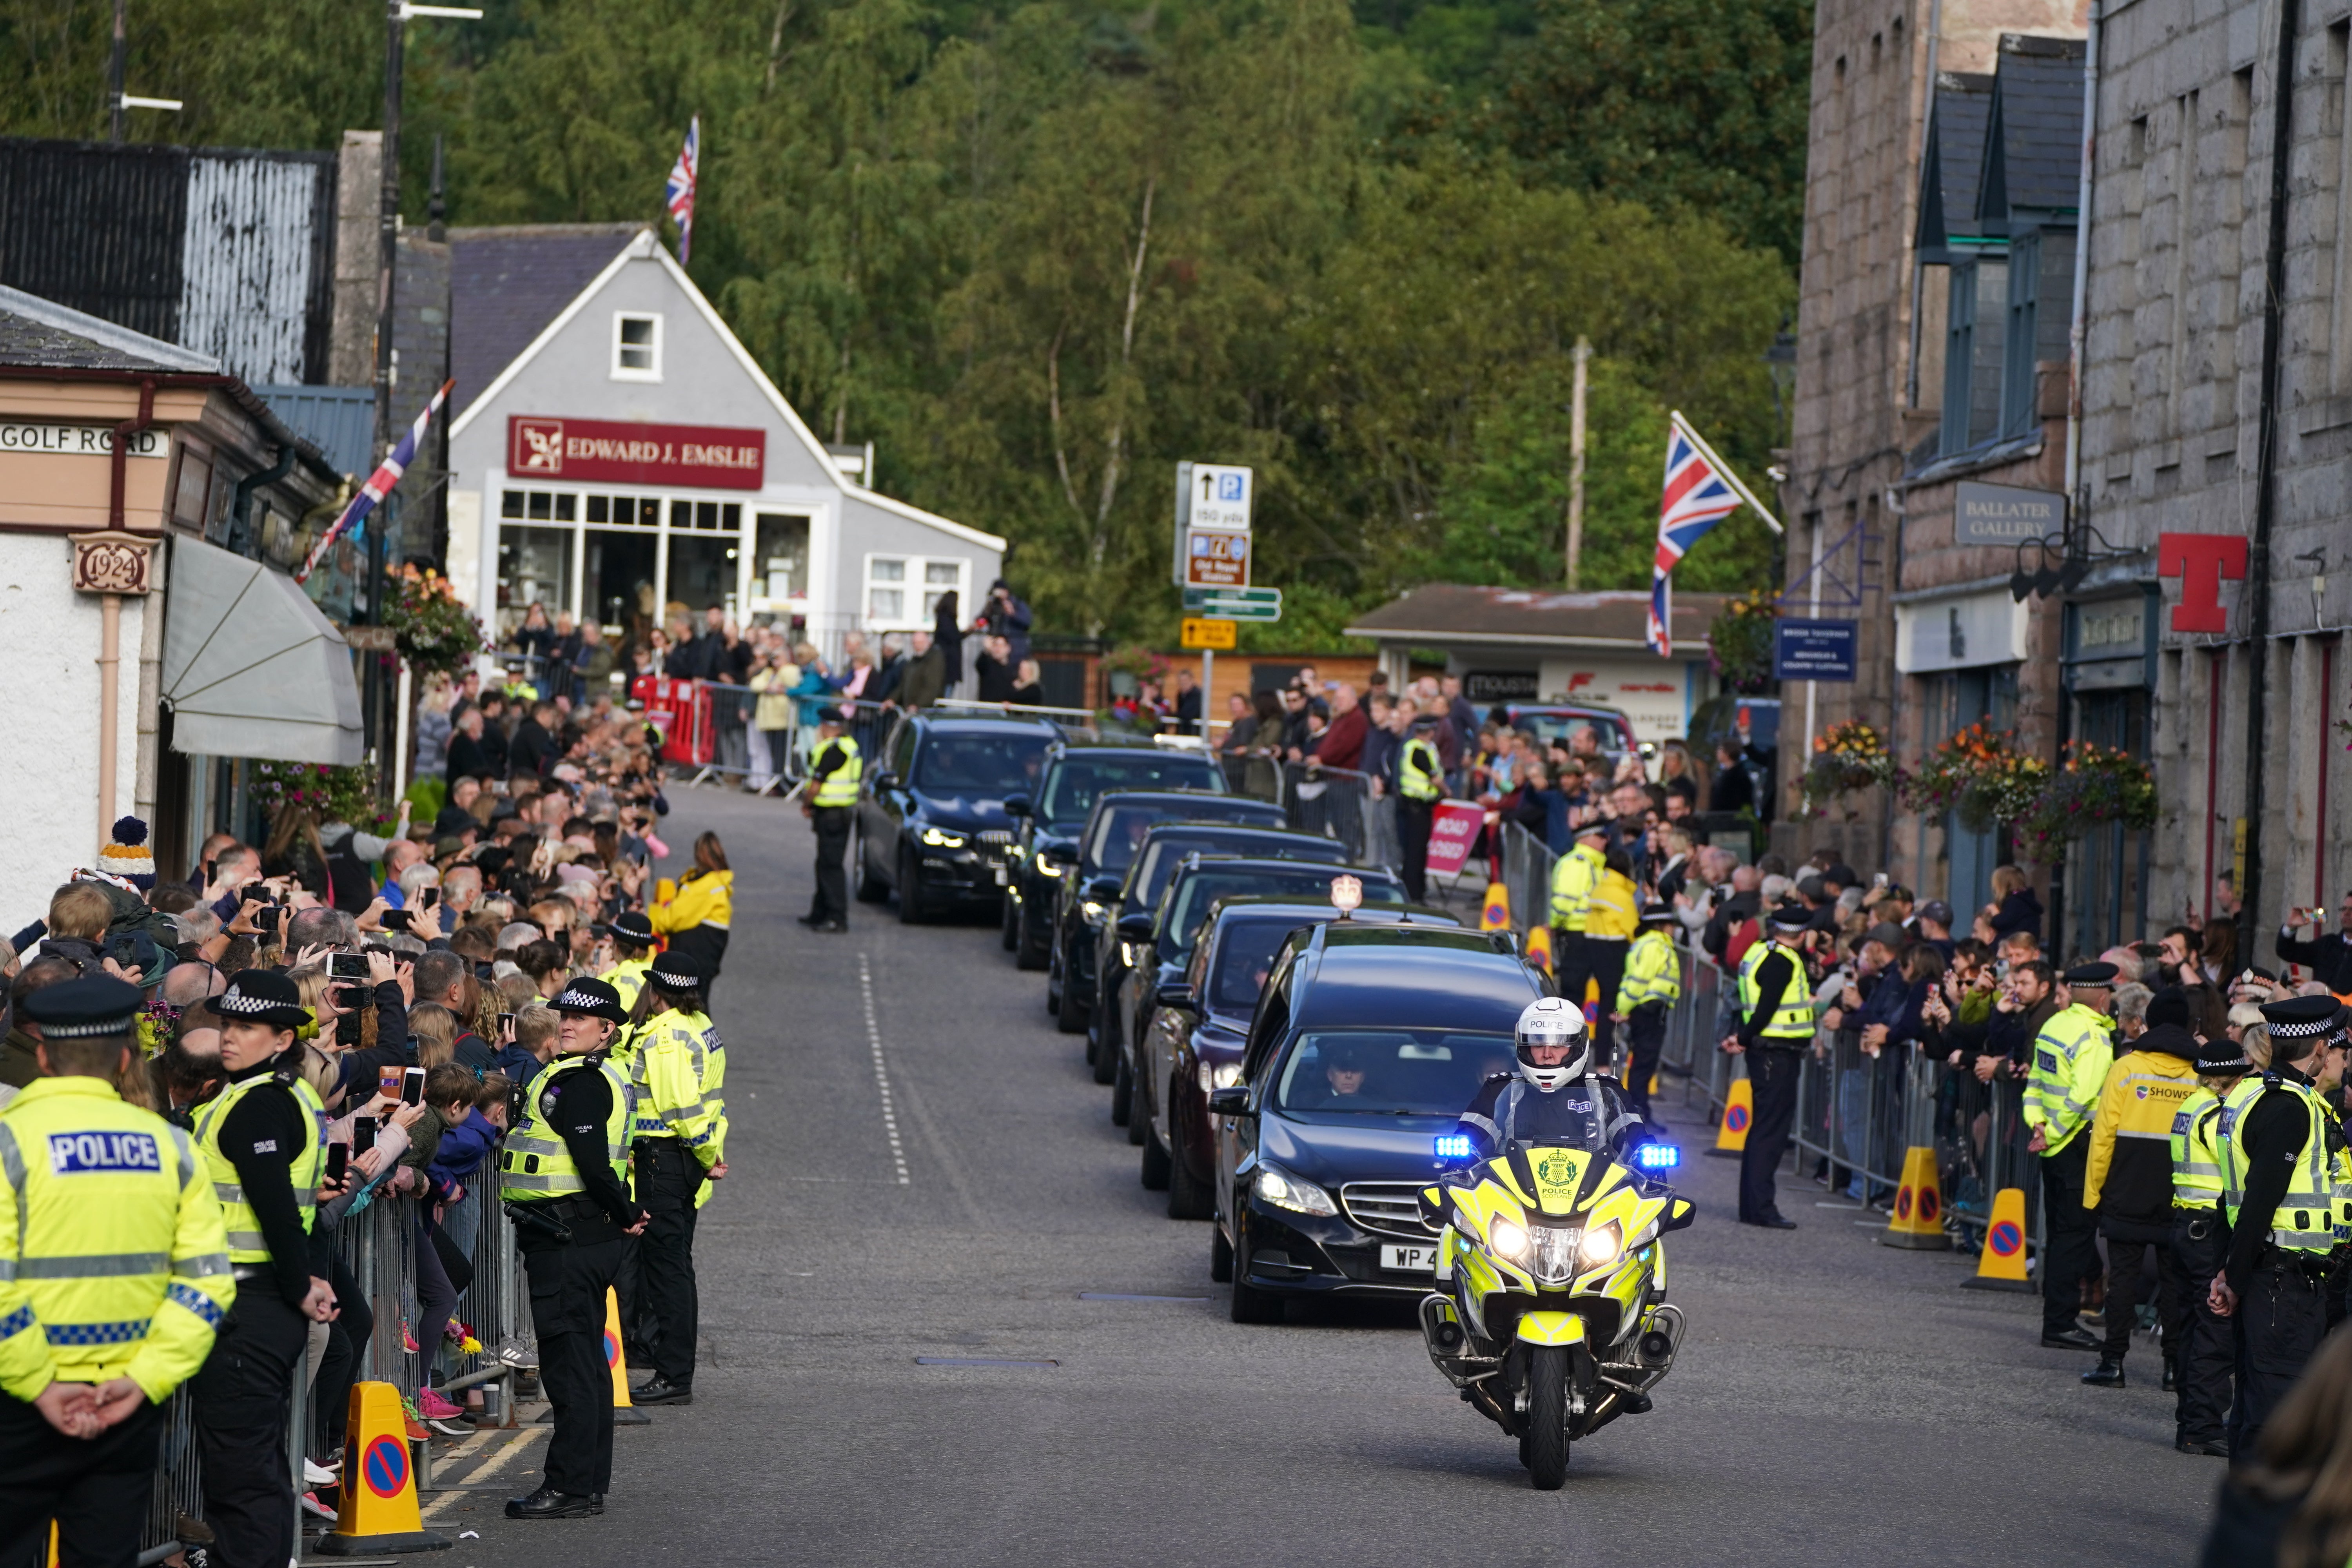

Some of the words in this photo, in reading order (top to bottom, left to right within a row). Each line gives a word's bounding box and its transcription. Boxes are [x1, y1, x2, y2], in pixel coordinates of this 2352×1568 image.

[2, 426, 71, 448] GOLF
[566, 436, 660, 463] EDWARD
[661, 442, 677, 465] J.
[681, 443, 760, 470] EMSLIE
[1966, 501, 2051, 518] BALLATER
[1969, 520, 2045, 538] GALLERY
[90, 554, 136, 577] 1924
[1436, 817, 1469, 837] ROAD
[1427, 838, 1465, 859] LOSED
[1530, 1020, 1563, 1030] POLICE
[519, 1119, 532, 1128] OLICE
[54, 1134, 158, 1168] POLICE
[1396, 1248, 1421, 1267] WP
